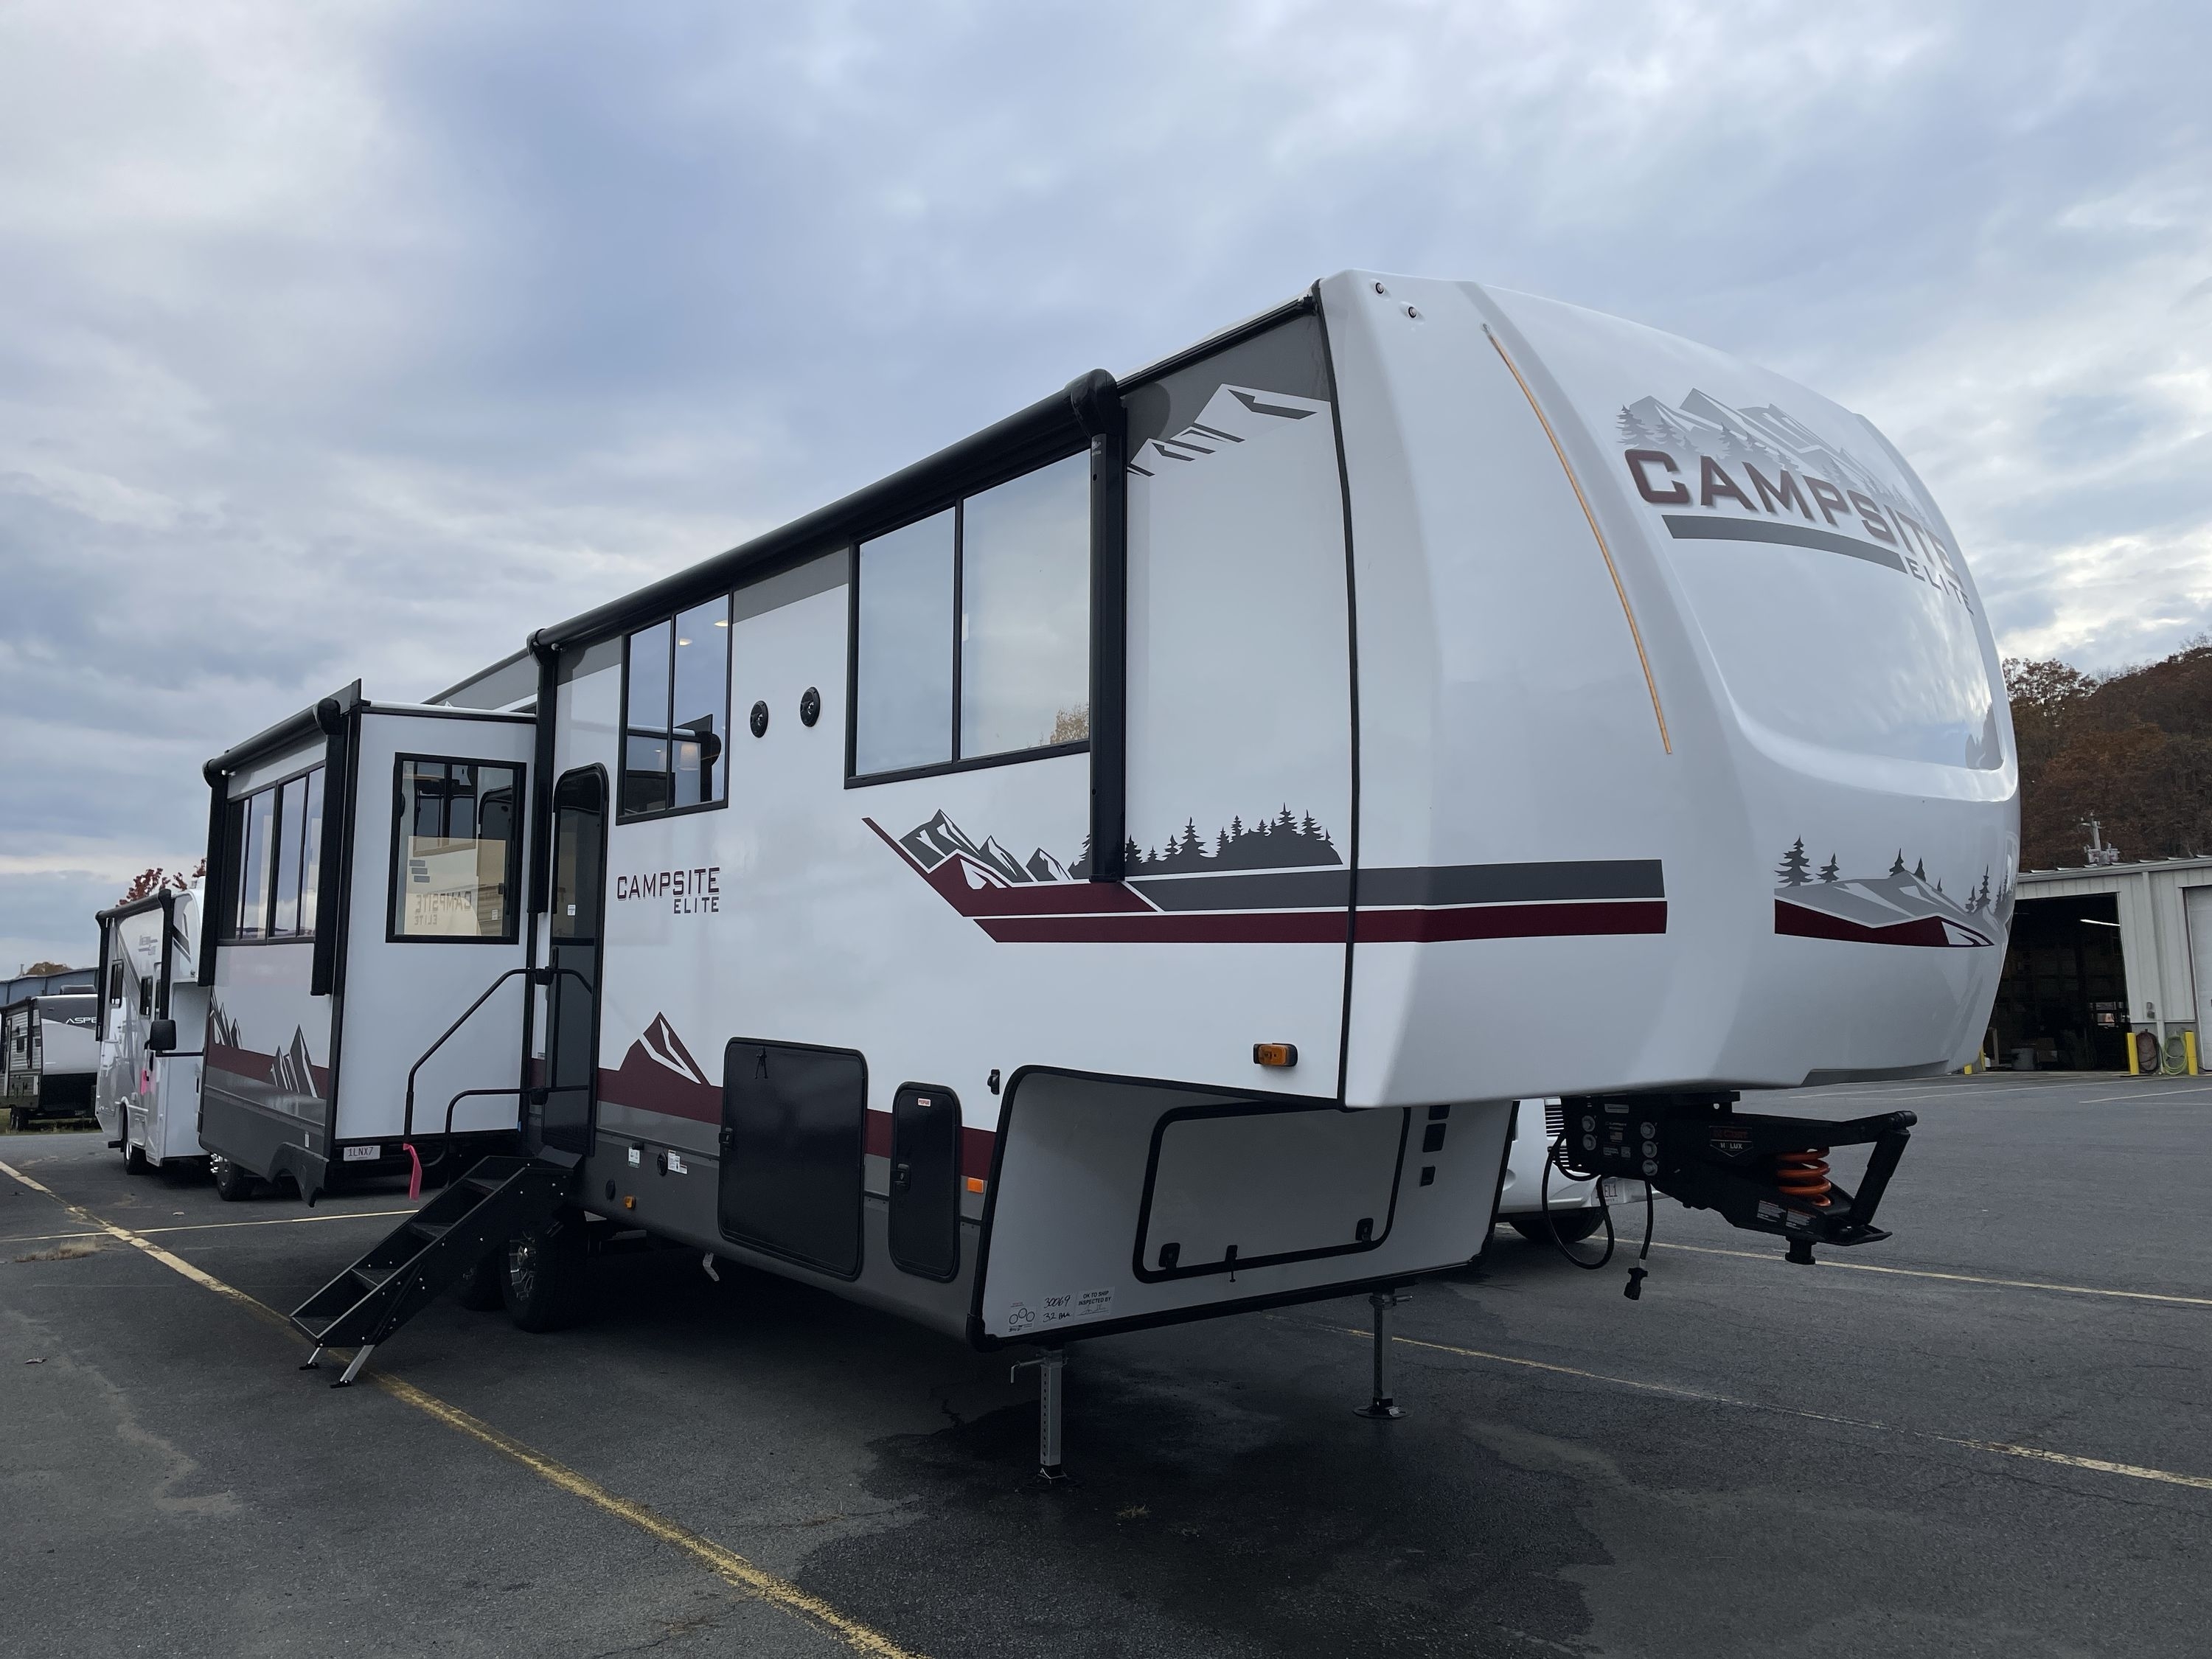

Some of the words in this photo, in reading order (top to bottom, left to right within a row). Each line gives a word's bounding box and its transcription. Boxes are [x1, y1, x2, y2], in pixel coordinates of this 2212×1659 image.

[1624, 448, 1964, 591] CAMPSITE
[1905, 556, 1974, 616] ELITE
[617, 867, 720, 900] CAMPSITE
[674, 897, 719, 914] ELITE
[348, 1147, 374, 1156] 1LNX7
